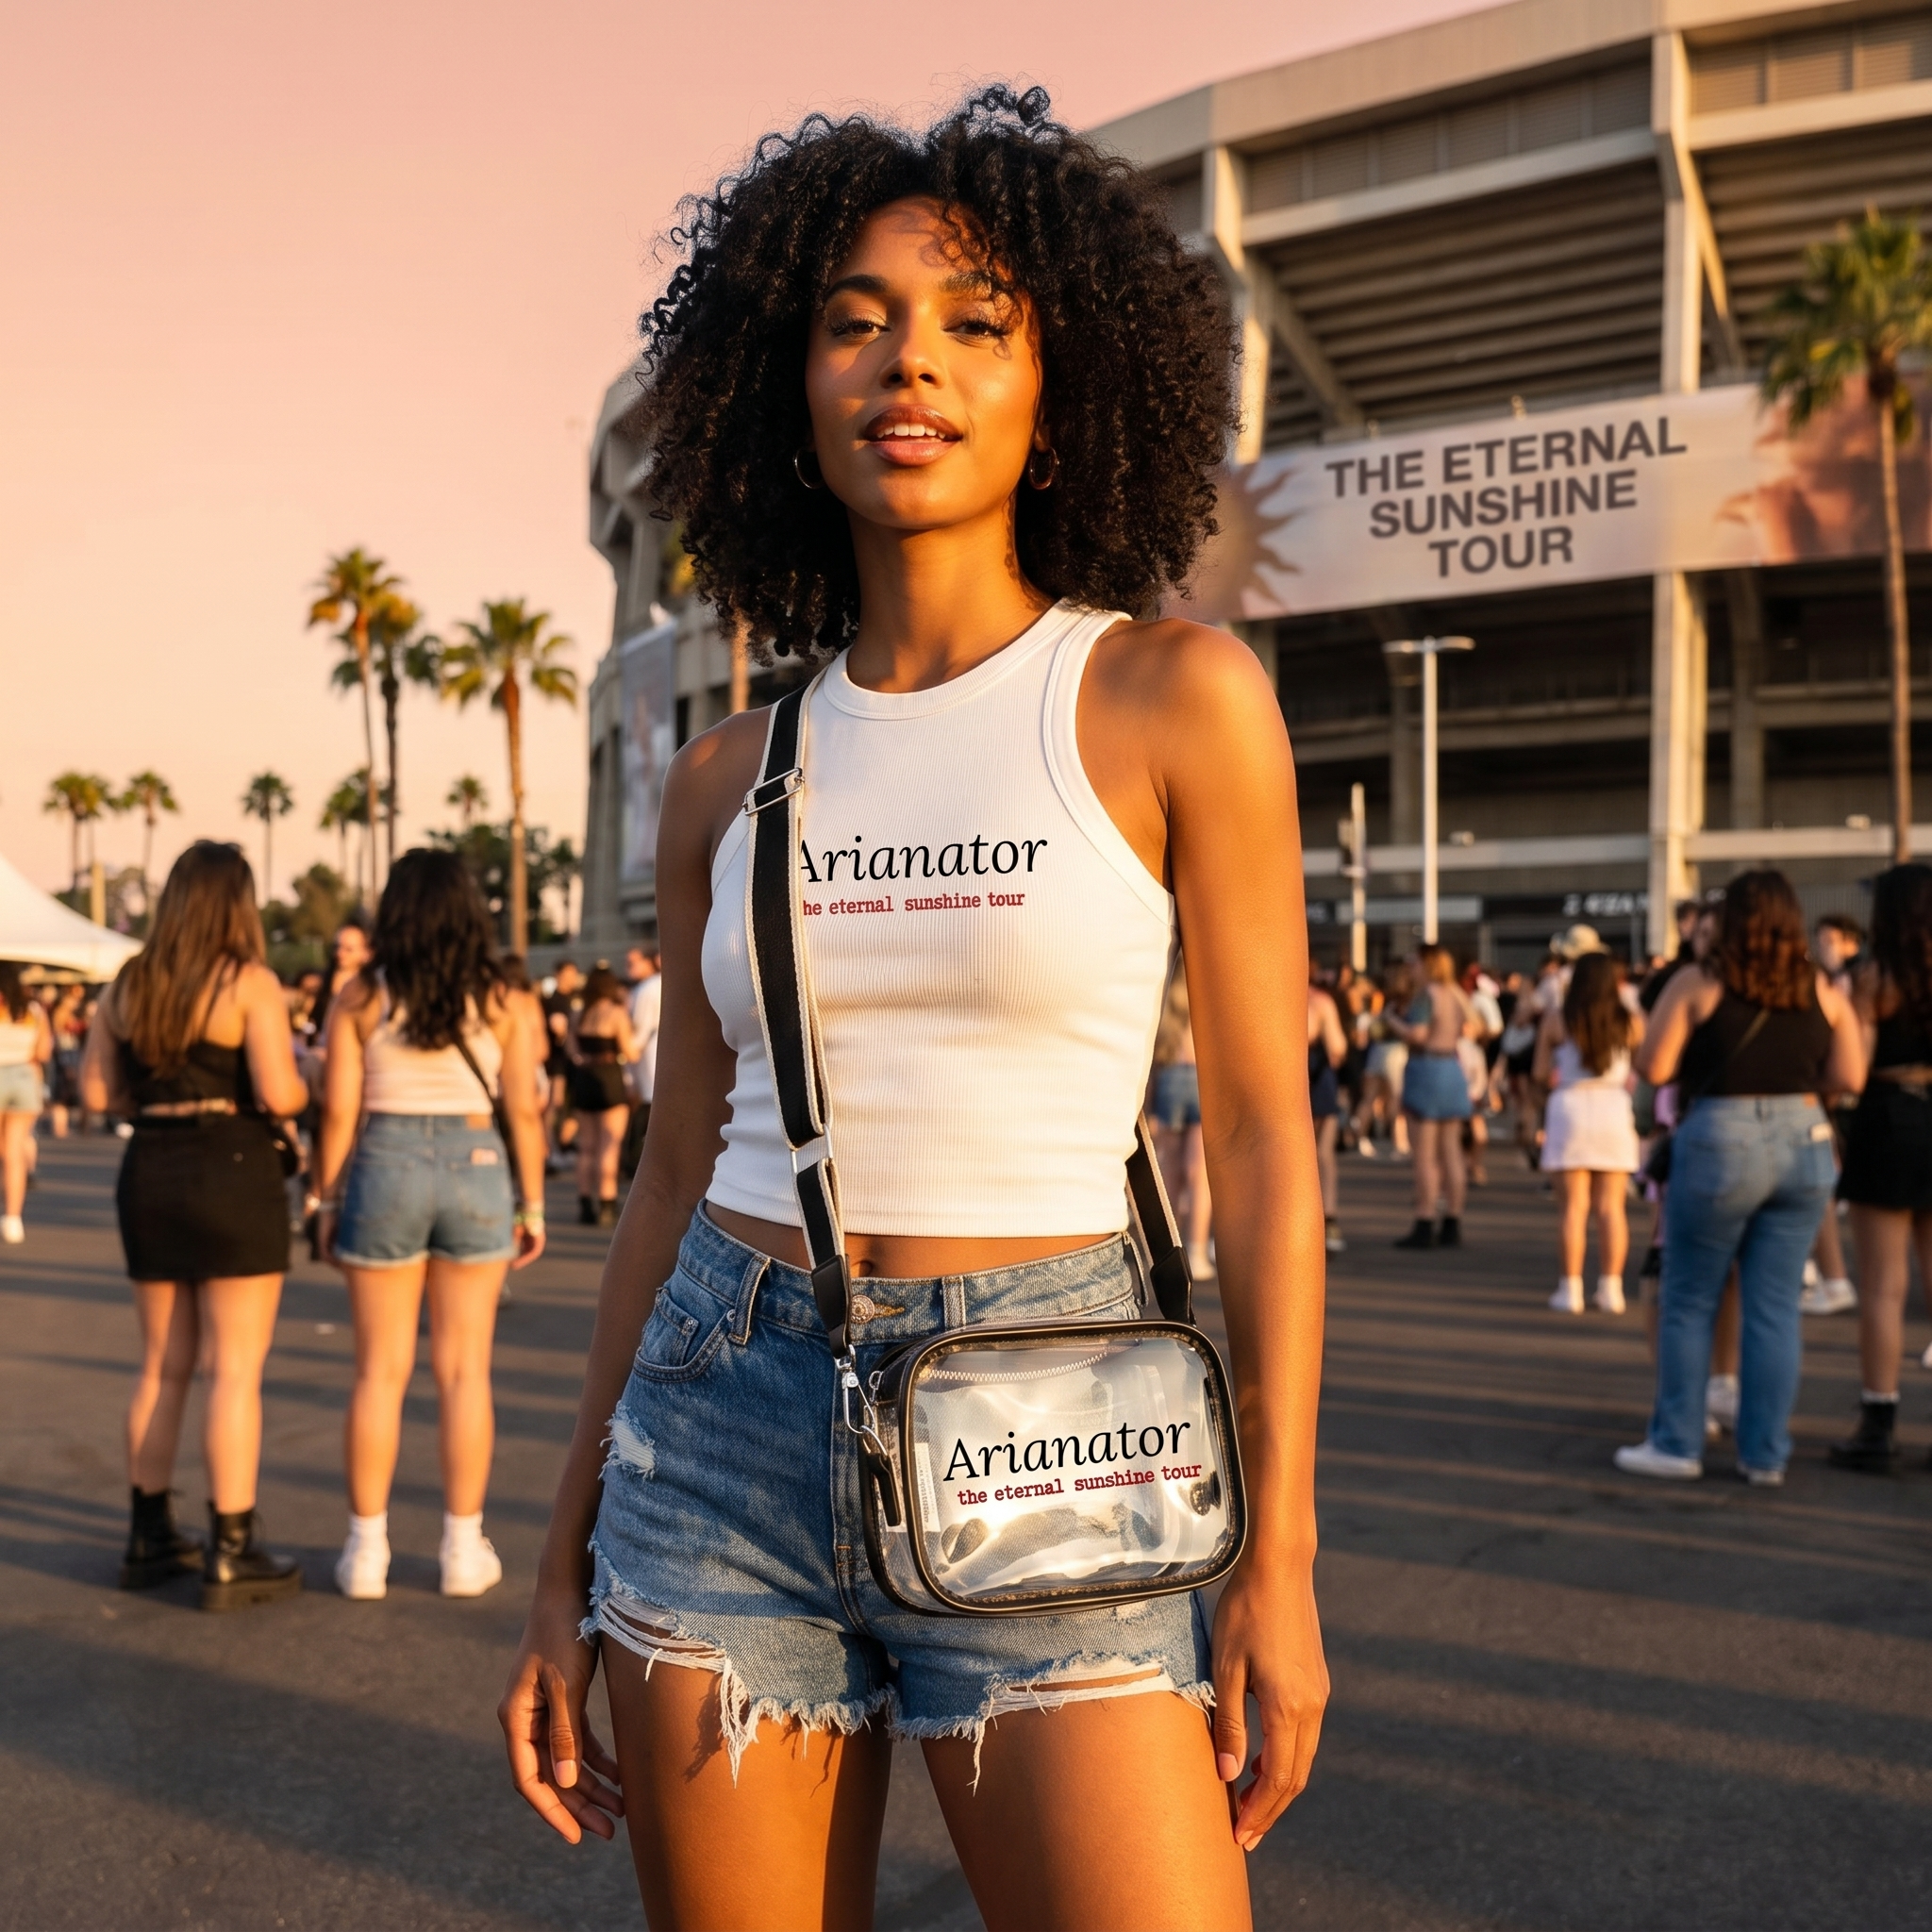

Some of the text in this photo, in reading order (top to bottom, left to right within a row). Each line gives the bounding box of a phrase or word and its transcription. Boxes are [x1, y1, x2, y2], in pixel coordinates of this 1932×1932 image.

[1325, 416, 1687, 498] THE ETERNAL
[1369, 470, 1637, 539] SUNSHINE
[1428, 525, 1573, 577] TOUR
[802, 891, 1025, 916] he eternal sunshine tour
[942, 1422, 1191, 1482] Arianator
[957, 1463, 1203, 1506] the eternal sunshine tour
